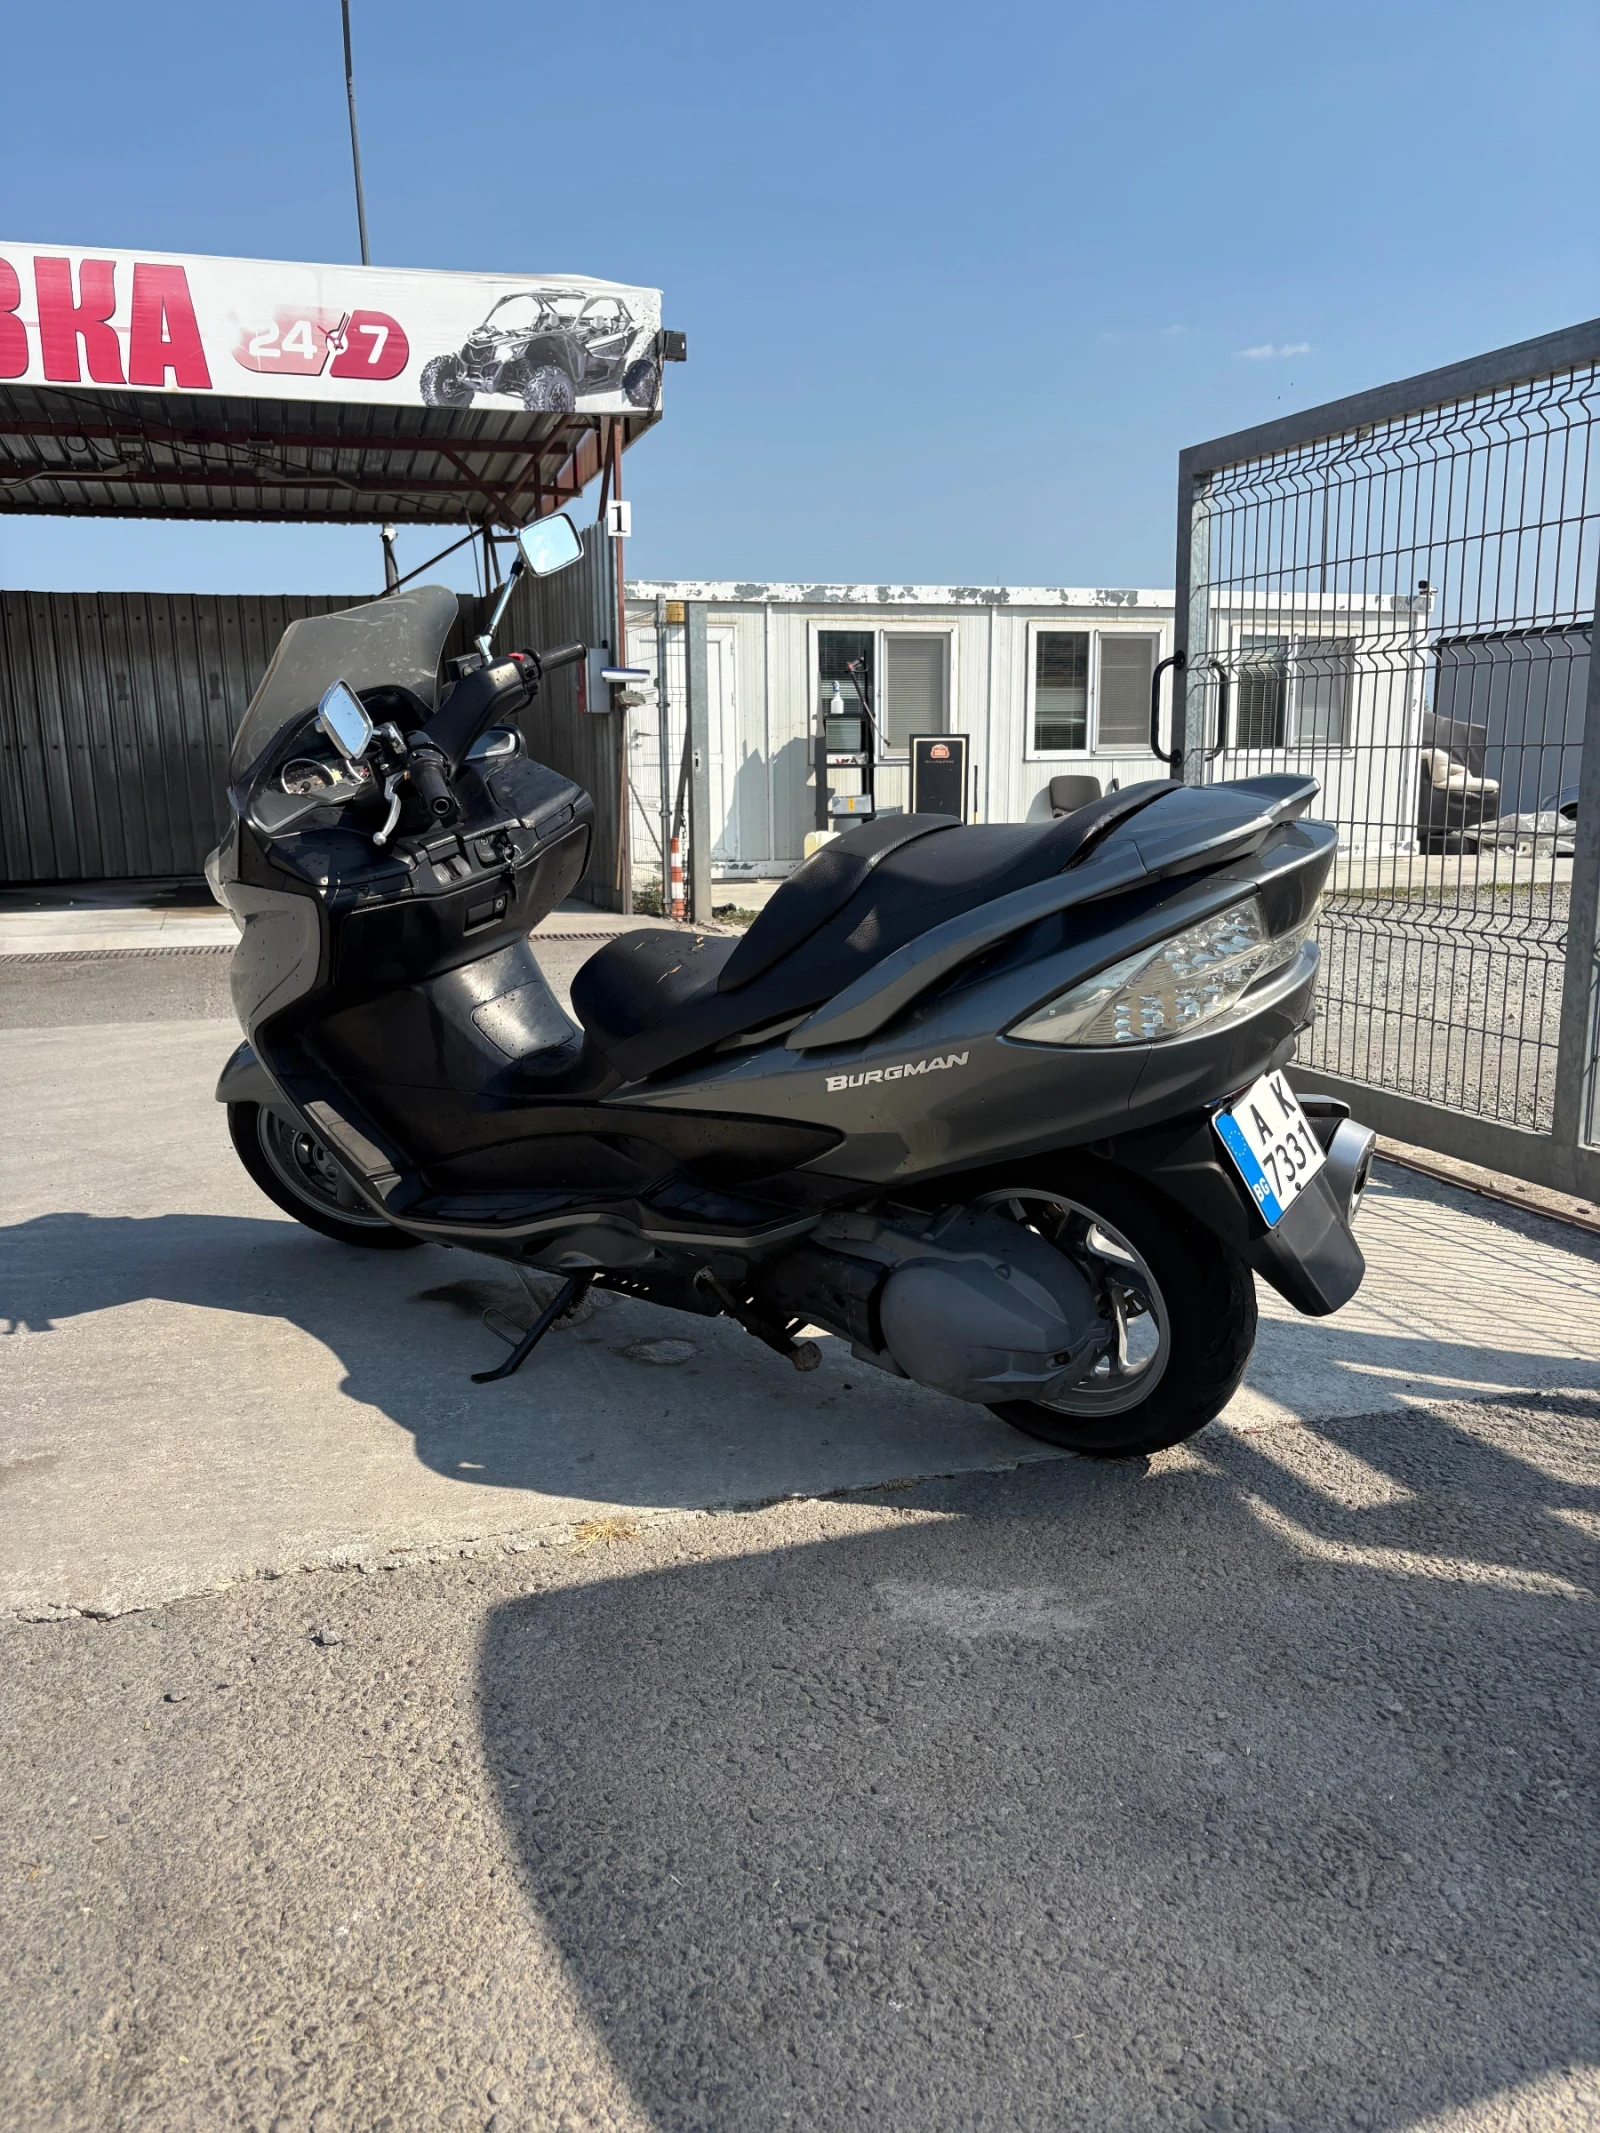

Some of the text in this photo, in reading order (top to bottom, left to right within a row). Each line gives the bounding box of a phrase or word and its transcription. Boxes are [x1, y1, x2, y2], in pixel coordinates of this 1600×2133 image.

[249, 317, 389, 364] 24 7
[610, 505, 627, 533] 1
[825, 1051, 970, 1092] BURGMAN
[1261, 1119, 1317, 1198] 7331
[1252, 1177, 1271, 1203] BG
